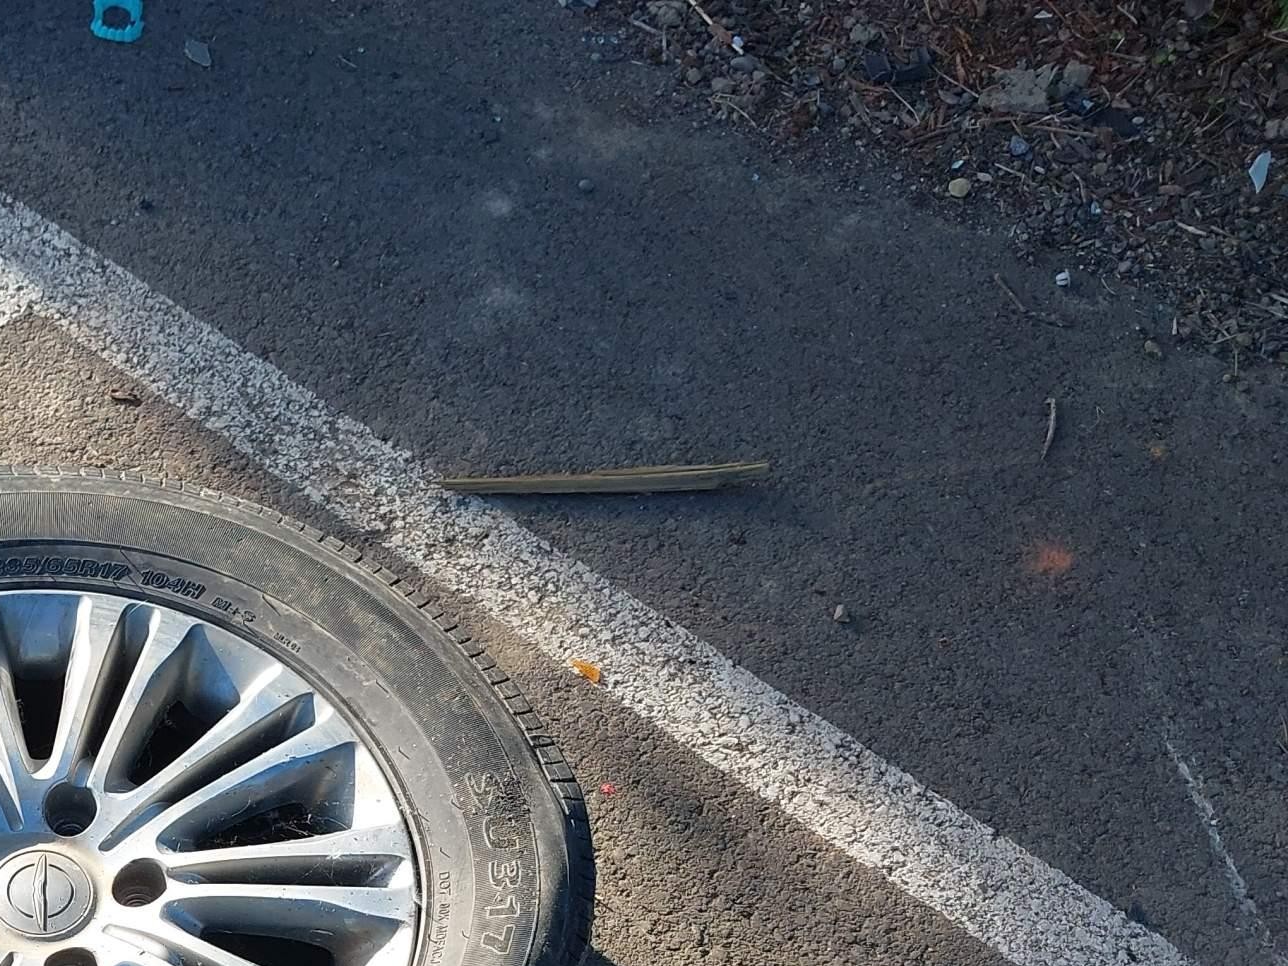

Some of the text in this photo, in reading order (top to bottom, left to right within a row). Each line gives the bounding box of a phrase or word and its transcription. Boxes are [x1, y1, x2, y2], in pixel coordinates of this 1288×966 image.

[140, 569, 207, 599] 104H
[465, 770, 519, 956] SU317
[436, 871, 452, 896] DOT
